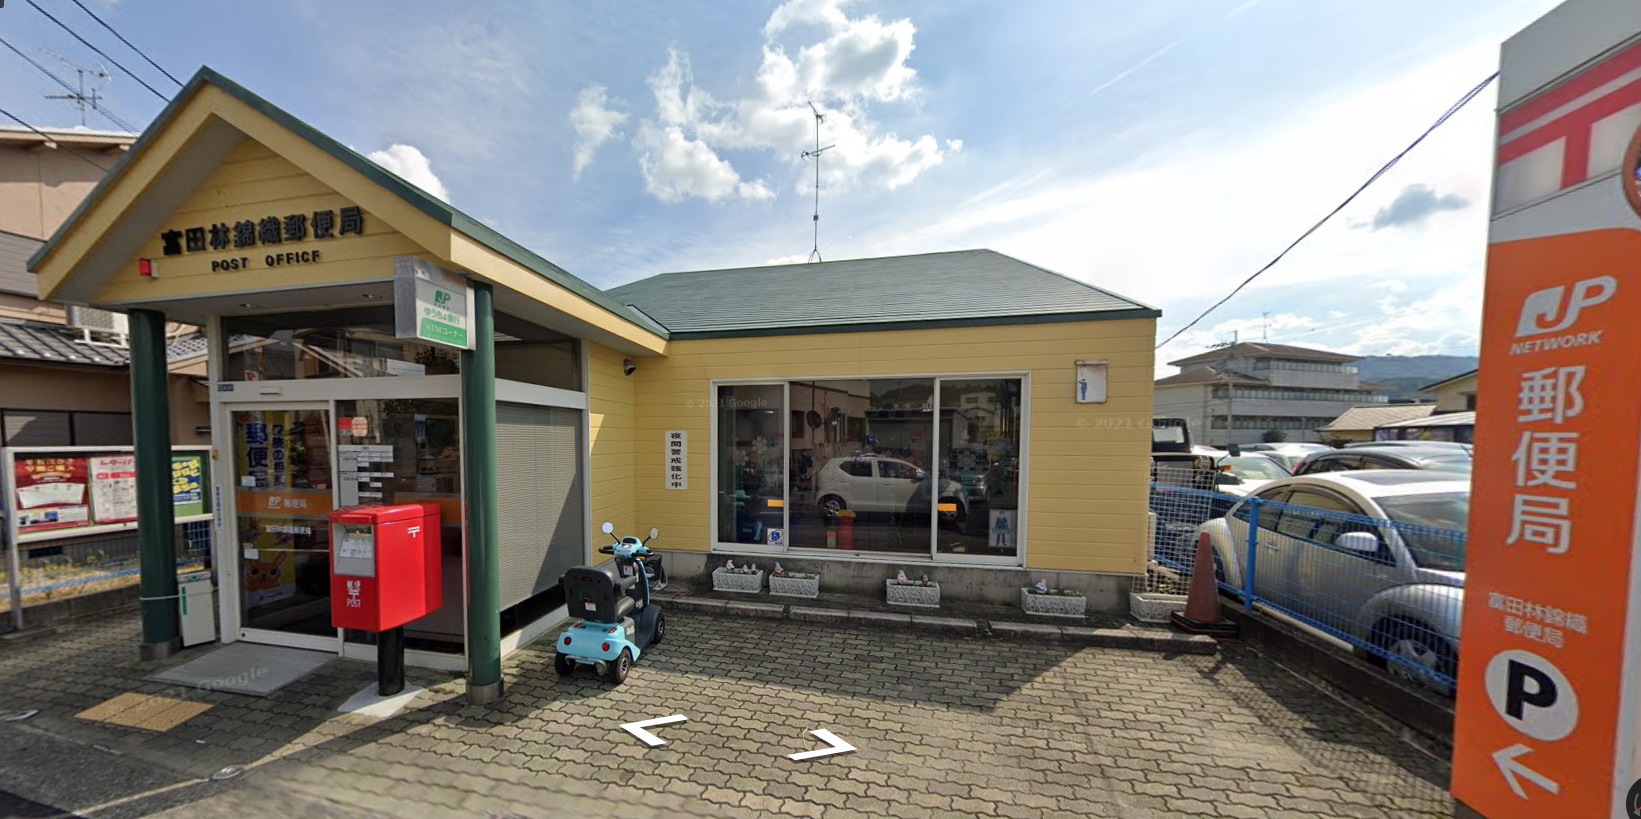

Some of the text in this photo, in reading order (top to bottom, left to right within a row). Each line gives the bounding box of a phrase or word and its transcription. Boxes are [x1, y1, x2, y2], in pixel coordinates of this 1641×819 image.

[161, 206, 364, 255] 富田林錦織郵便局
[211, 257, 248, 272] POST
[1515, 275, 1618, 338] JP
[1509, 329, 1603, 356] NETWORK
[670, 432, 682, 488] 夜間警戒強化中
[1506, 365, 1586, 555] 郵便局
[346, 598, 361, 608] POST
[1504, 658, 1558, 721] P
